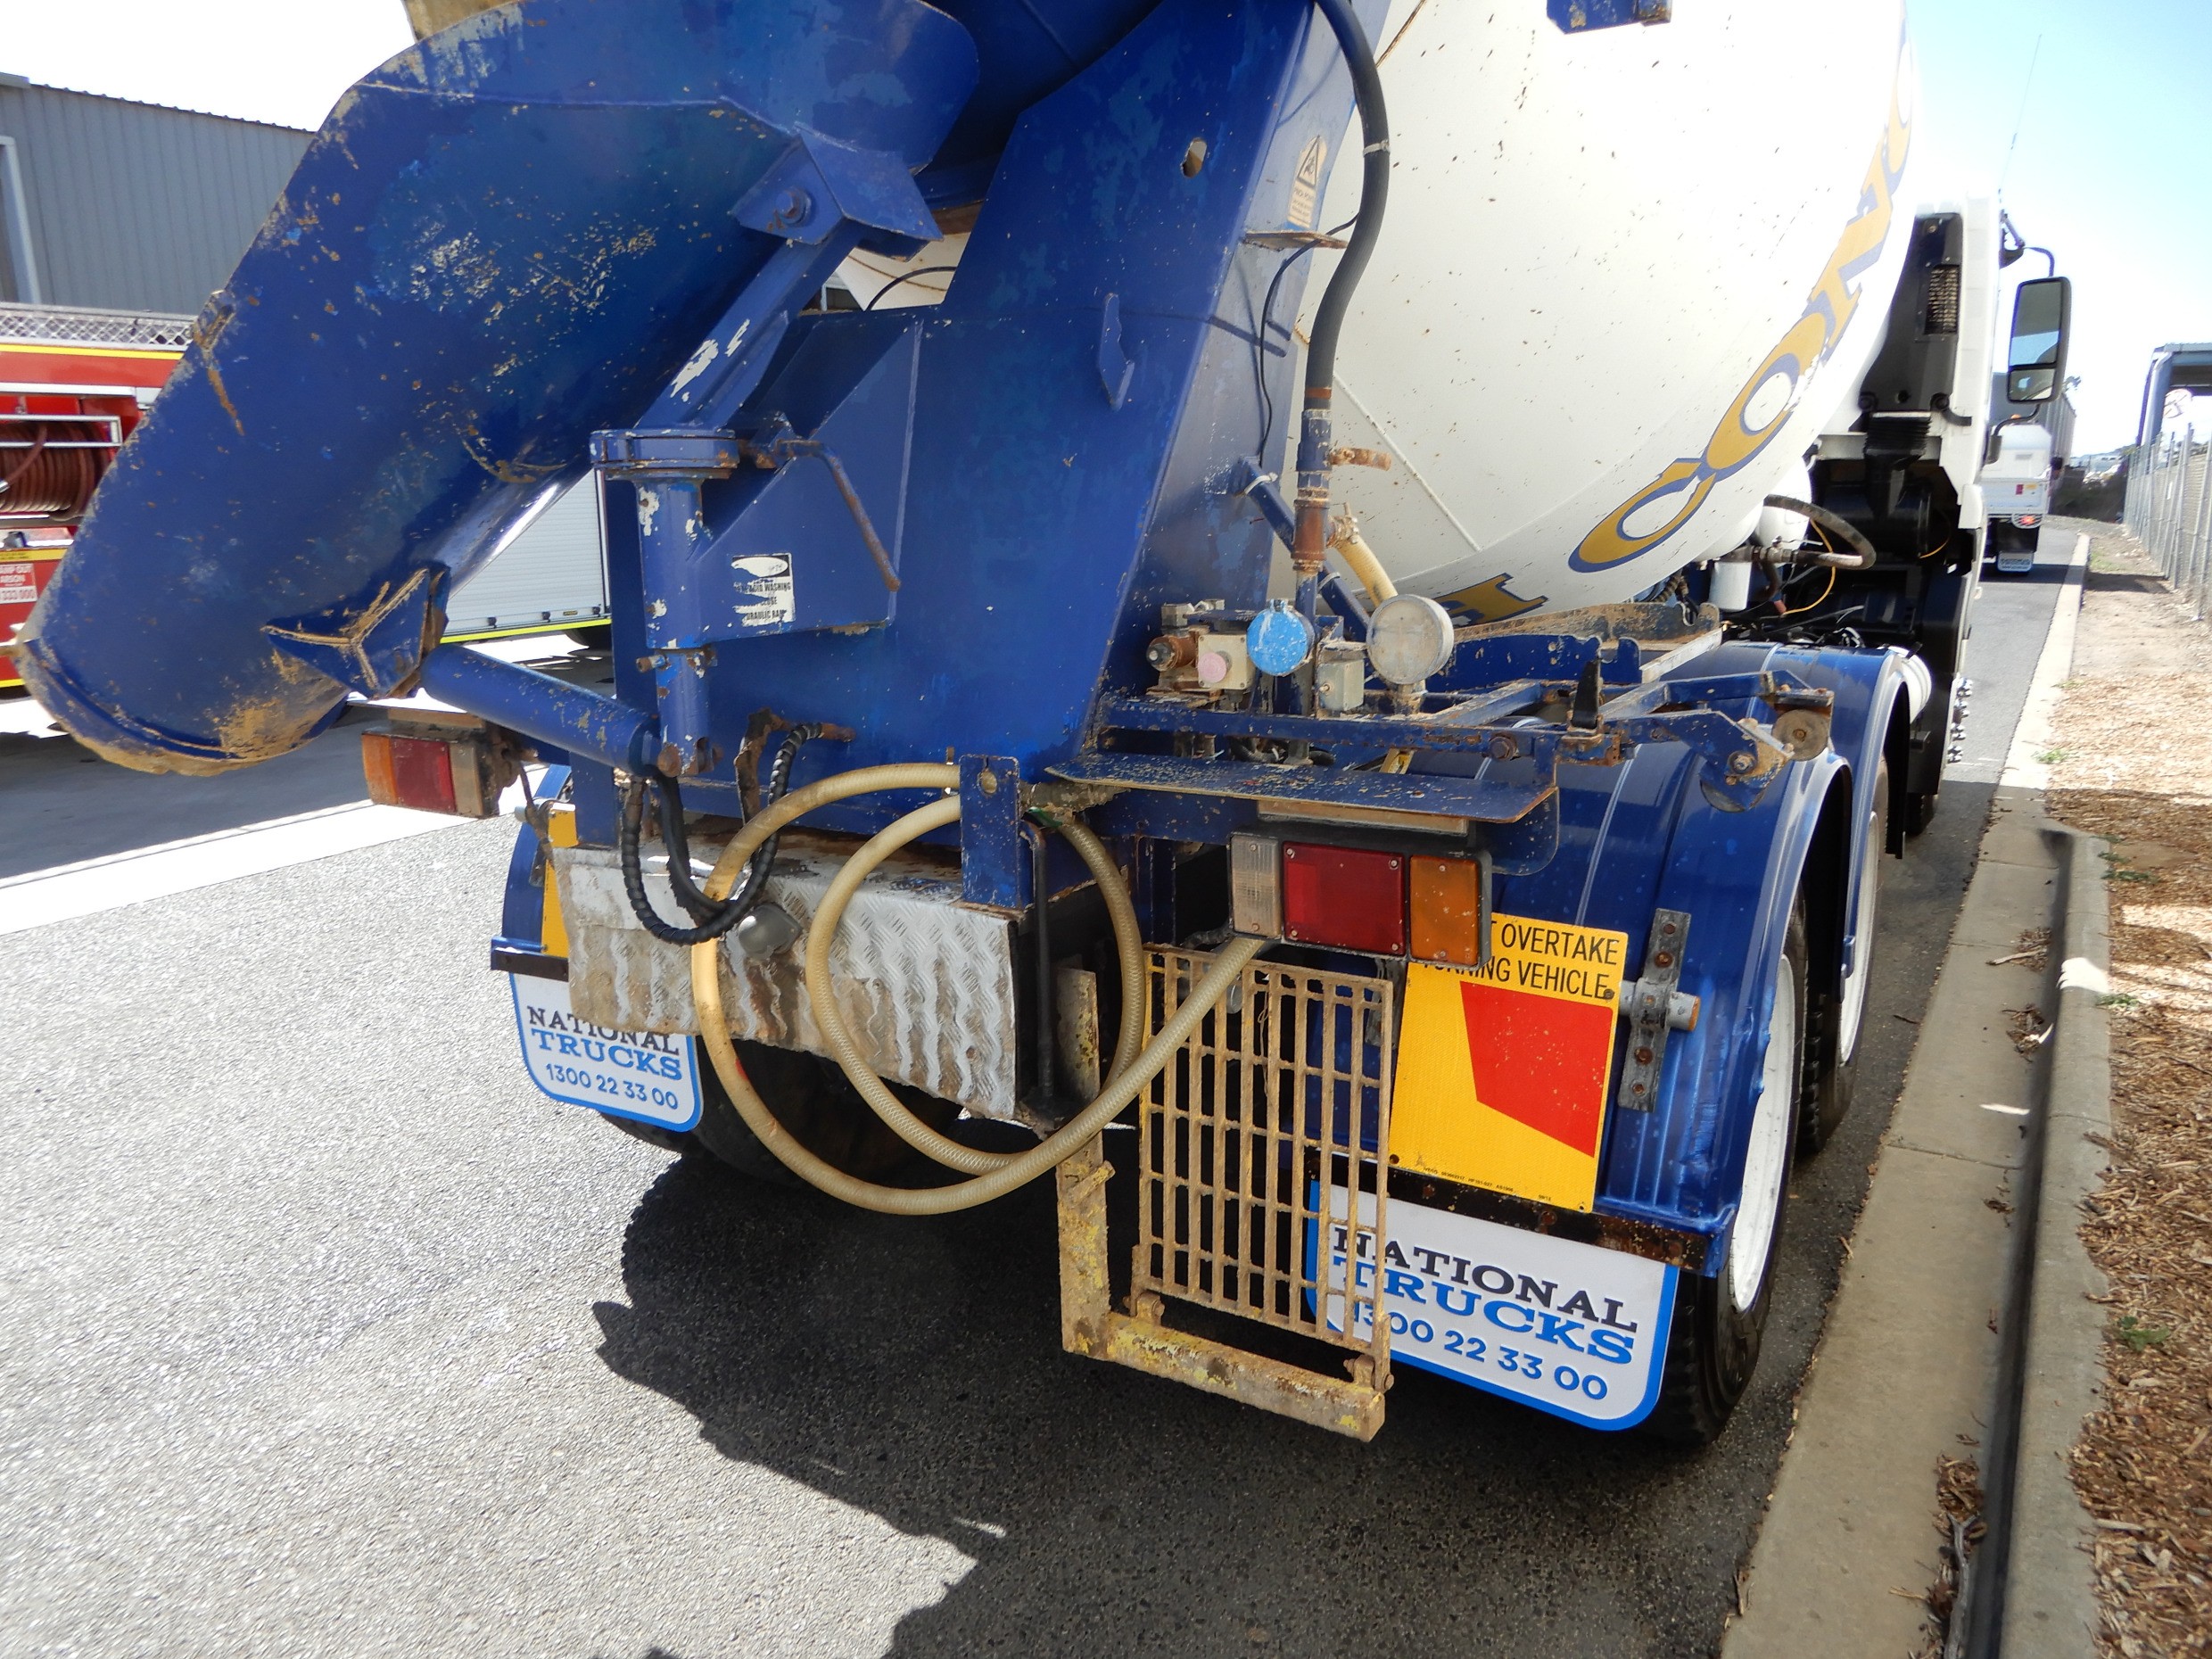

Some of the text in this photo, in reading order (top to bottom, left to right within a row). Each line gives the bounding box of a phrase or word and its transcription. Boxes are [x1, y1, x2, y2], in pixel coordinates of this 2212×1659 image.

[1501, 923, 1620, 966] OVERTAKE
[1518, 960, 1616, 1001] VEHICLE
[531, 1028, 683, 1081] TRUCKS
[546, 1063, 679, 1110] 1300 22 33 00
[1333, 1226, 1638, 1333] NATIONAL
[1333, 1255, 1635, 1365] TRUCKS
[1444, 1329, 1488, 1363] 22
[1498, 1345, 1543, 1381] 33
[1554, 1365, 1609, 1400] 00
